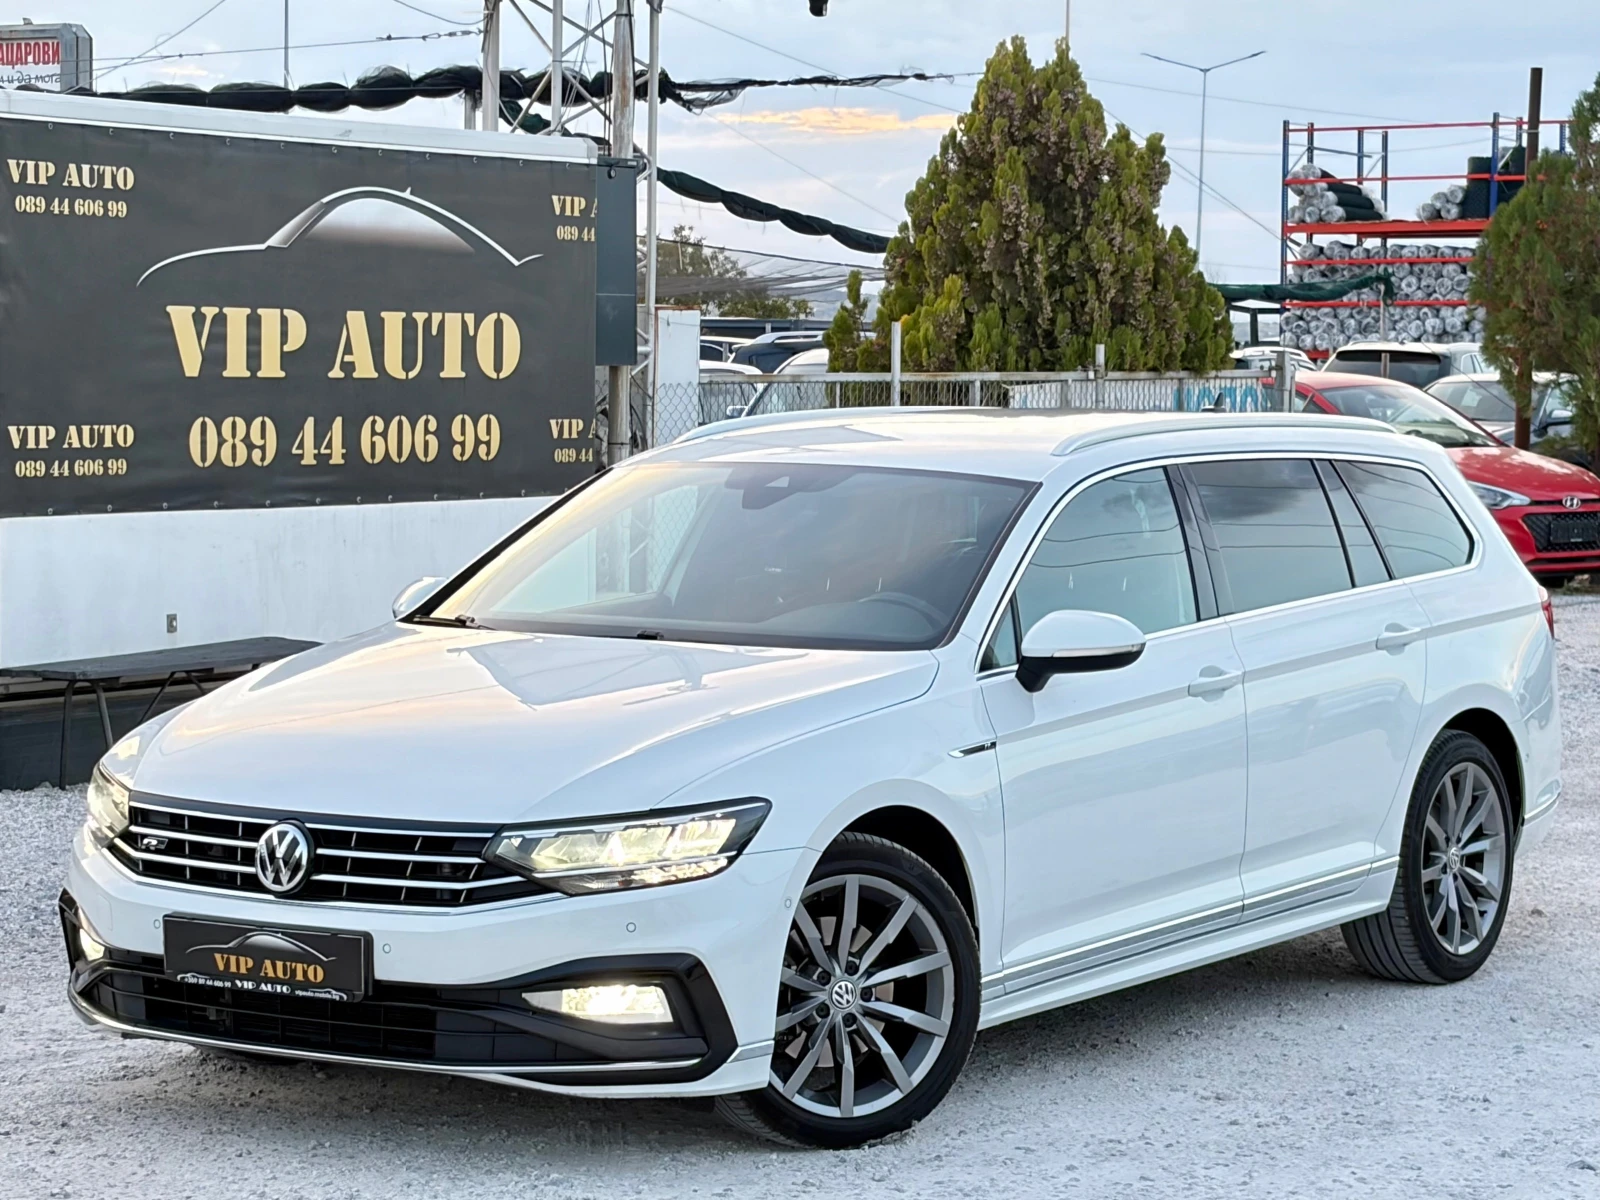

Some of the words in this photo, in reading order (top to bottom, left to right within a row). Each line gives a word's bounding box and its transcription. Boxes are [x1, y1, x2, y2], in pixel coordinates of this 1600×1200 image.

[7, 159, 56, 185] VIP
[62, 163, 135, 190] AUTO
[15, 195, 46, 213] 089
[50, 197, 70, 215] 44
[74, 198, 104, 217] 606
[107, 200, 127, 218] 99
[551, 194, 586, 217] VIP
[556, 225, 579, 241] 089
[581, 226, 596, 242] 44
[165, 304, 308, 379] VIP
[327, 310, 521, 380] AUTO
[7, 425, 56, 449] VIP
[62, 424, 135, 448] AUTO
[549, 418, 584, 439] VIP
[188, 415, 278, 468] 089
[291, 415, 347, 466] 44
[360, 414, 439, 464] 606
[450, 413, 501, 462] 99
[554, 447, 577, 463] 089
[579, 447, 593, 463] 44
[15, 460, 46, 477] 089
[50, 460, 70, 477] 44
[74, 459, 104, 476] 606
[107, 458, 127, 475] 99
[213, 952, 254, 974] VIP
[260, 958, 325, 983] AUTO
[235, 979, 256, 990] VIP
[259, 982, 292, 994] AUTO
